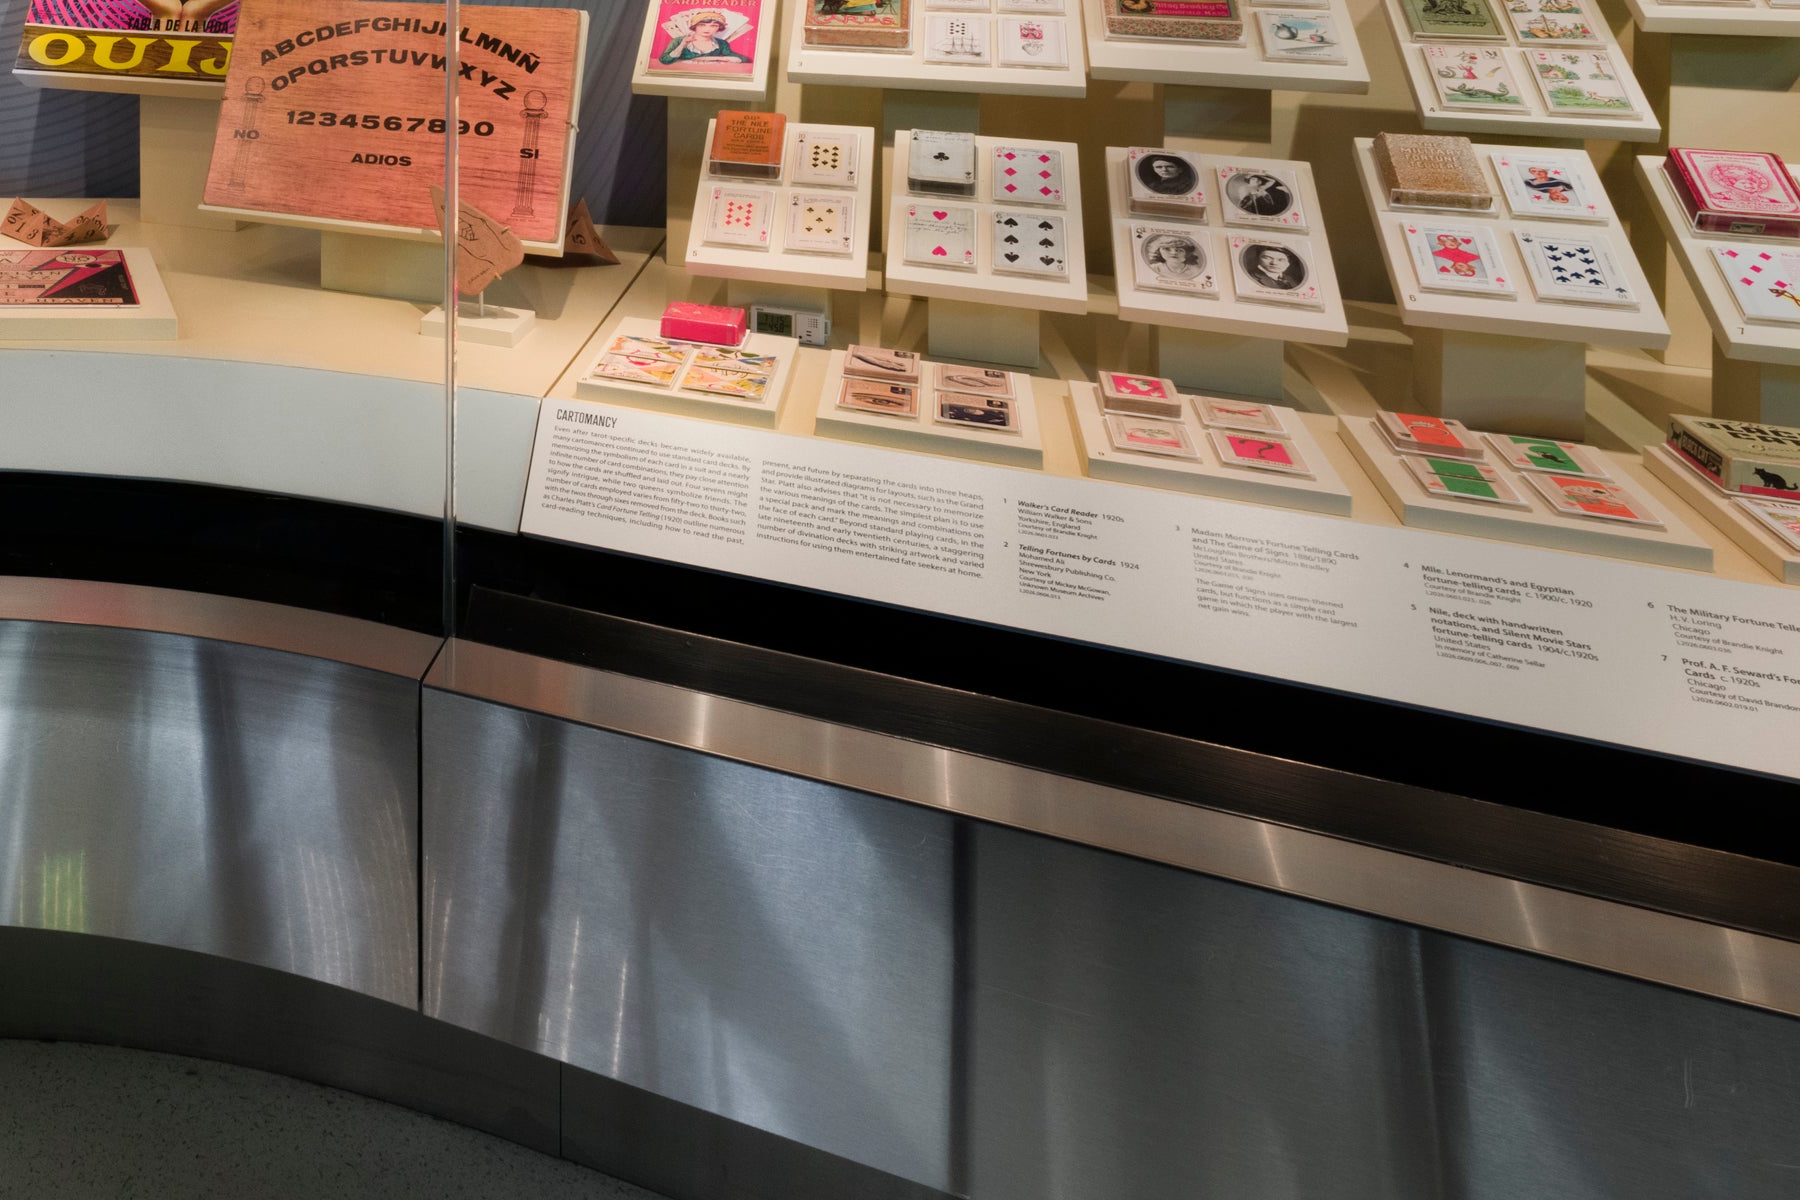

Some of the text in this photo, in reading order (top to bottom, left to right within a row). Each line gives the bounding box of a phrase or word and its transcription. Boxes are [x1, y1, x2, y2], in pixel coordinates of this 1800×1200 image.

[127, 17, 229, 34] TABLA DE LA VIDA
[233, 128, 260, 141] NO
[350, 152, 413, 168] ADIOS
[556, 408, 618, 429] CARTOMANCY
[1049, 504, 1070, 514] Card
[1070, 507, 1098, 518] Reader
[1102, 513, 1124, 522] 1920s
[1018, 543, 1140, 570] Telling Fortunes by Cards 1924
